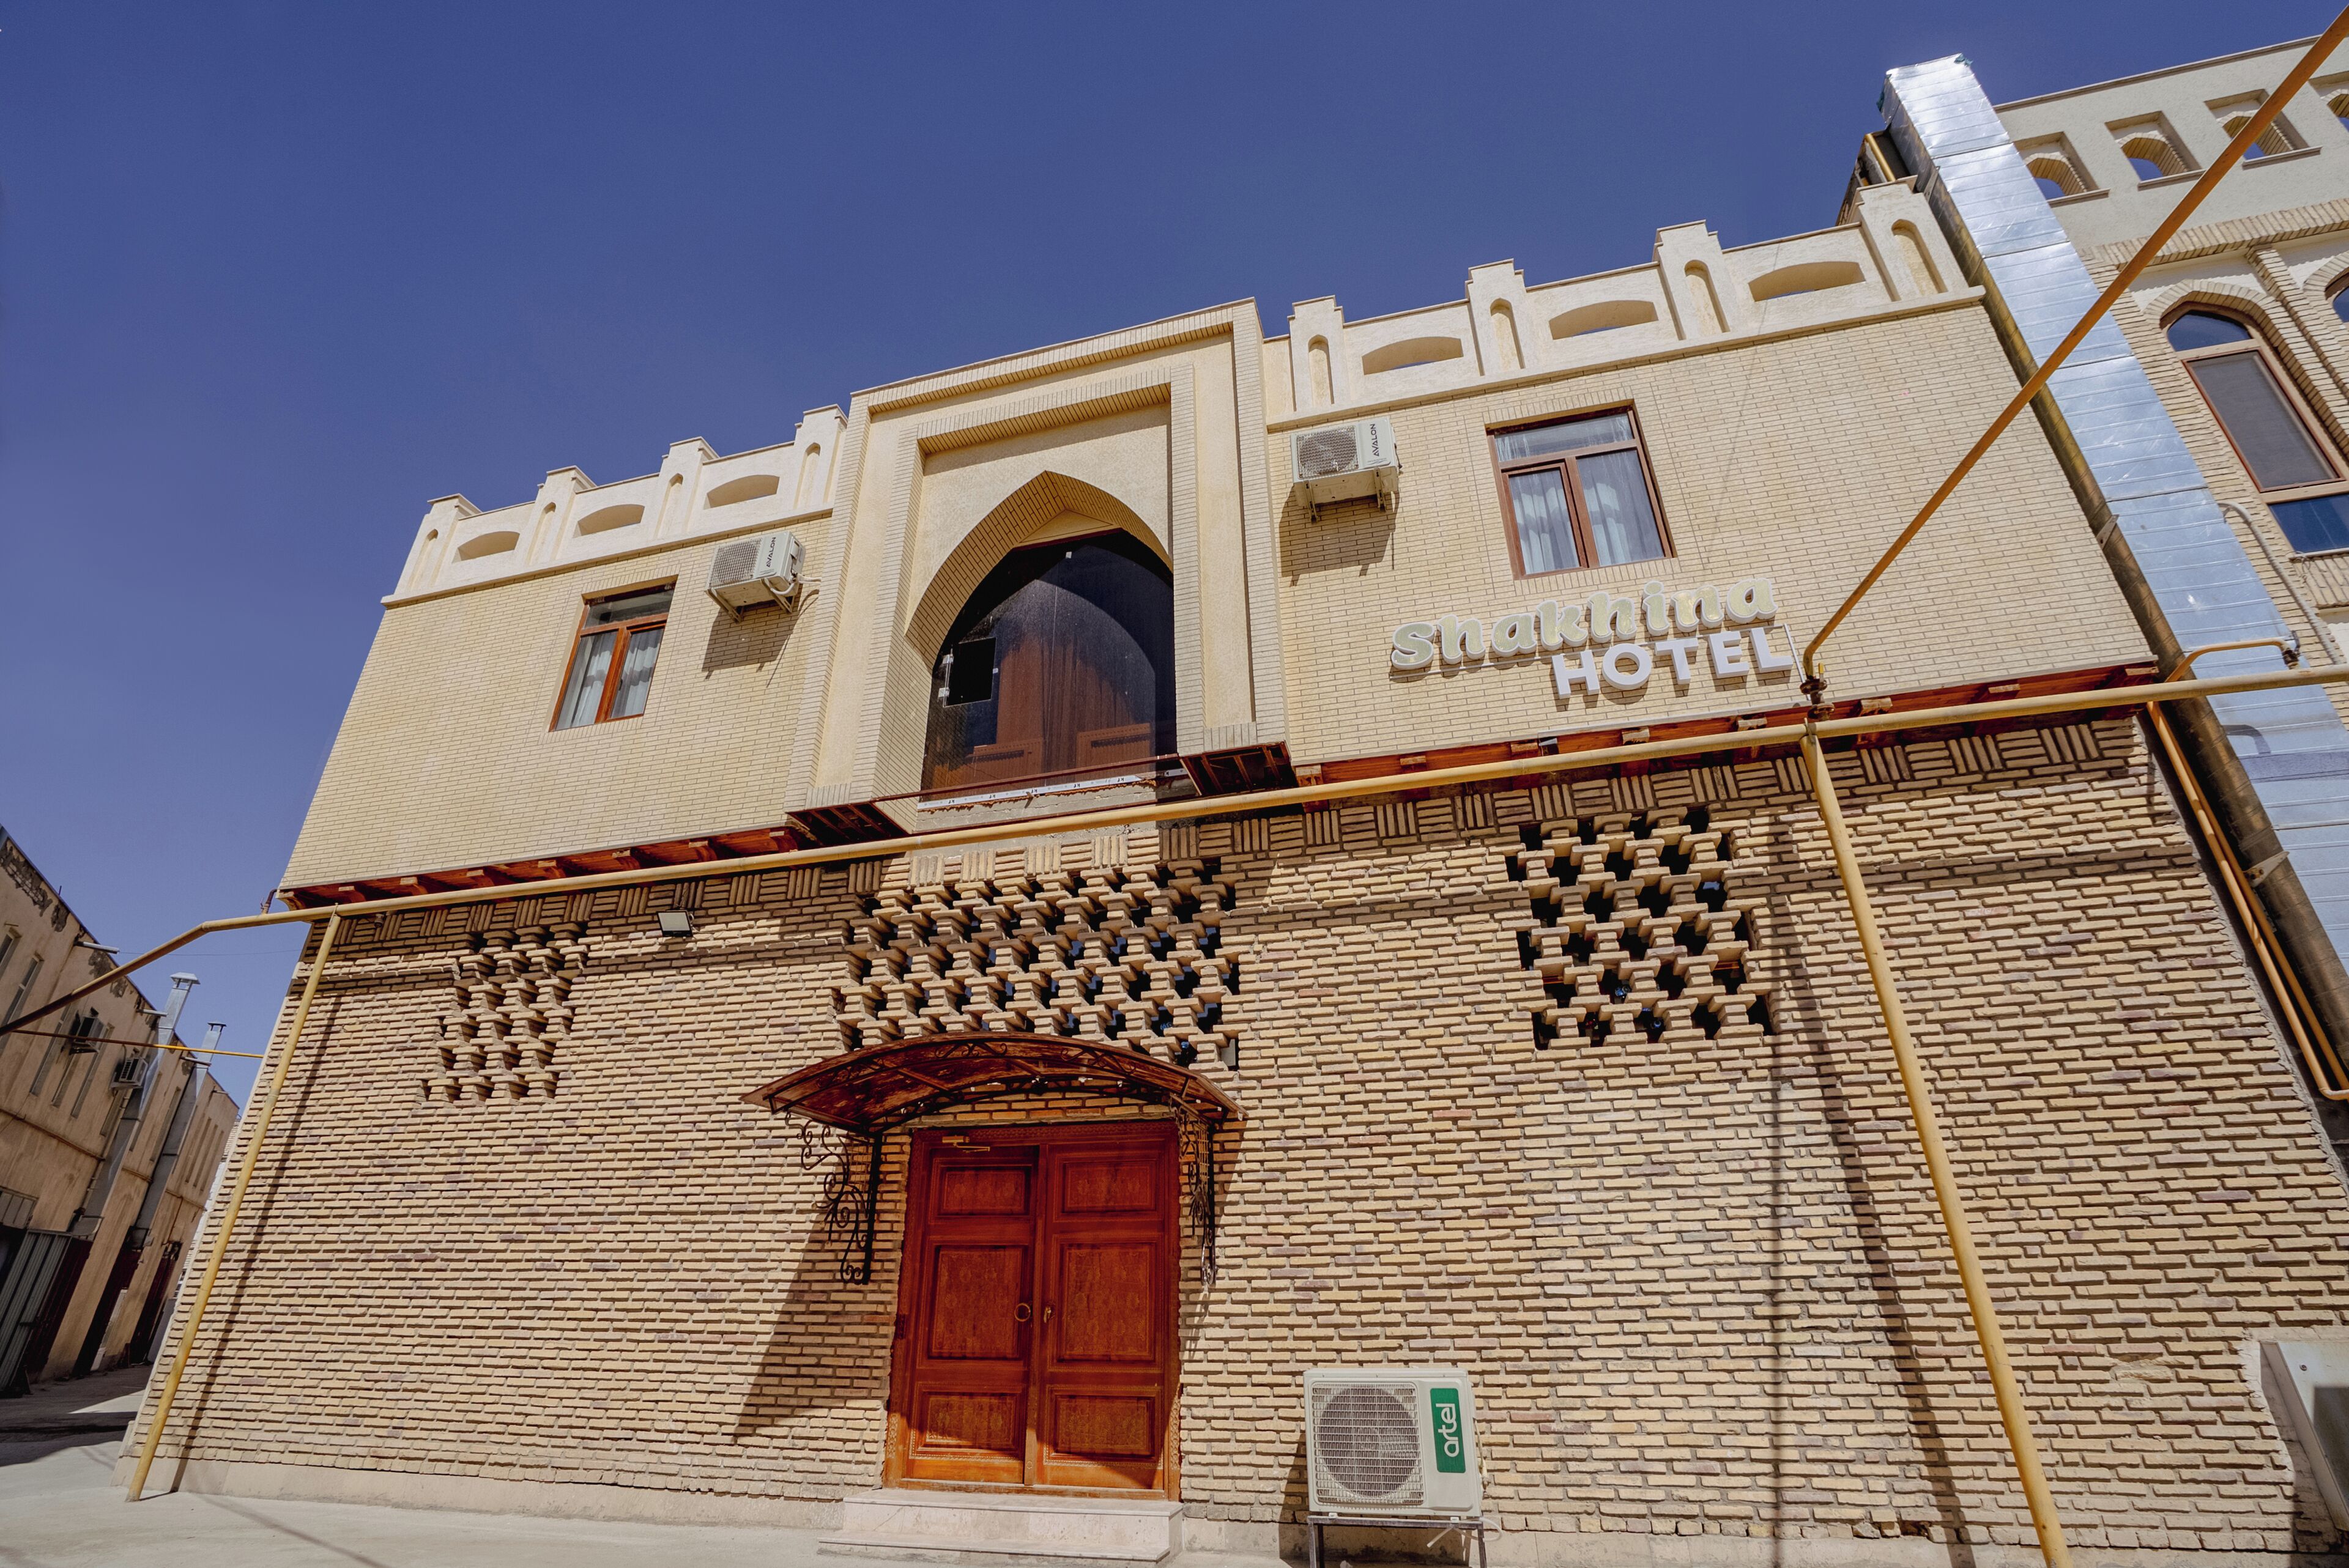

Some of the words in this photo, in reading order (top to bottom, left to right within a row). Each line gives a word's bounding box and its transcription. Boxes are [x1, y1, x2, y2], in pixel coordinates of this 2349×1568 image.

[1370, 424, 1379, 457] AVALON
[766, 537, 776, 568] AVALON
[1552, 627, 1794, 699] HOTEL
[1436, 1403, 1460, 1457] artel
